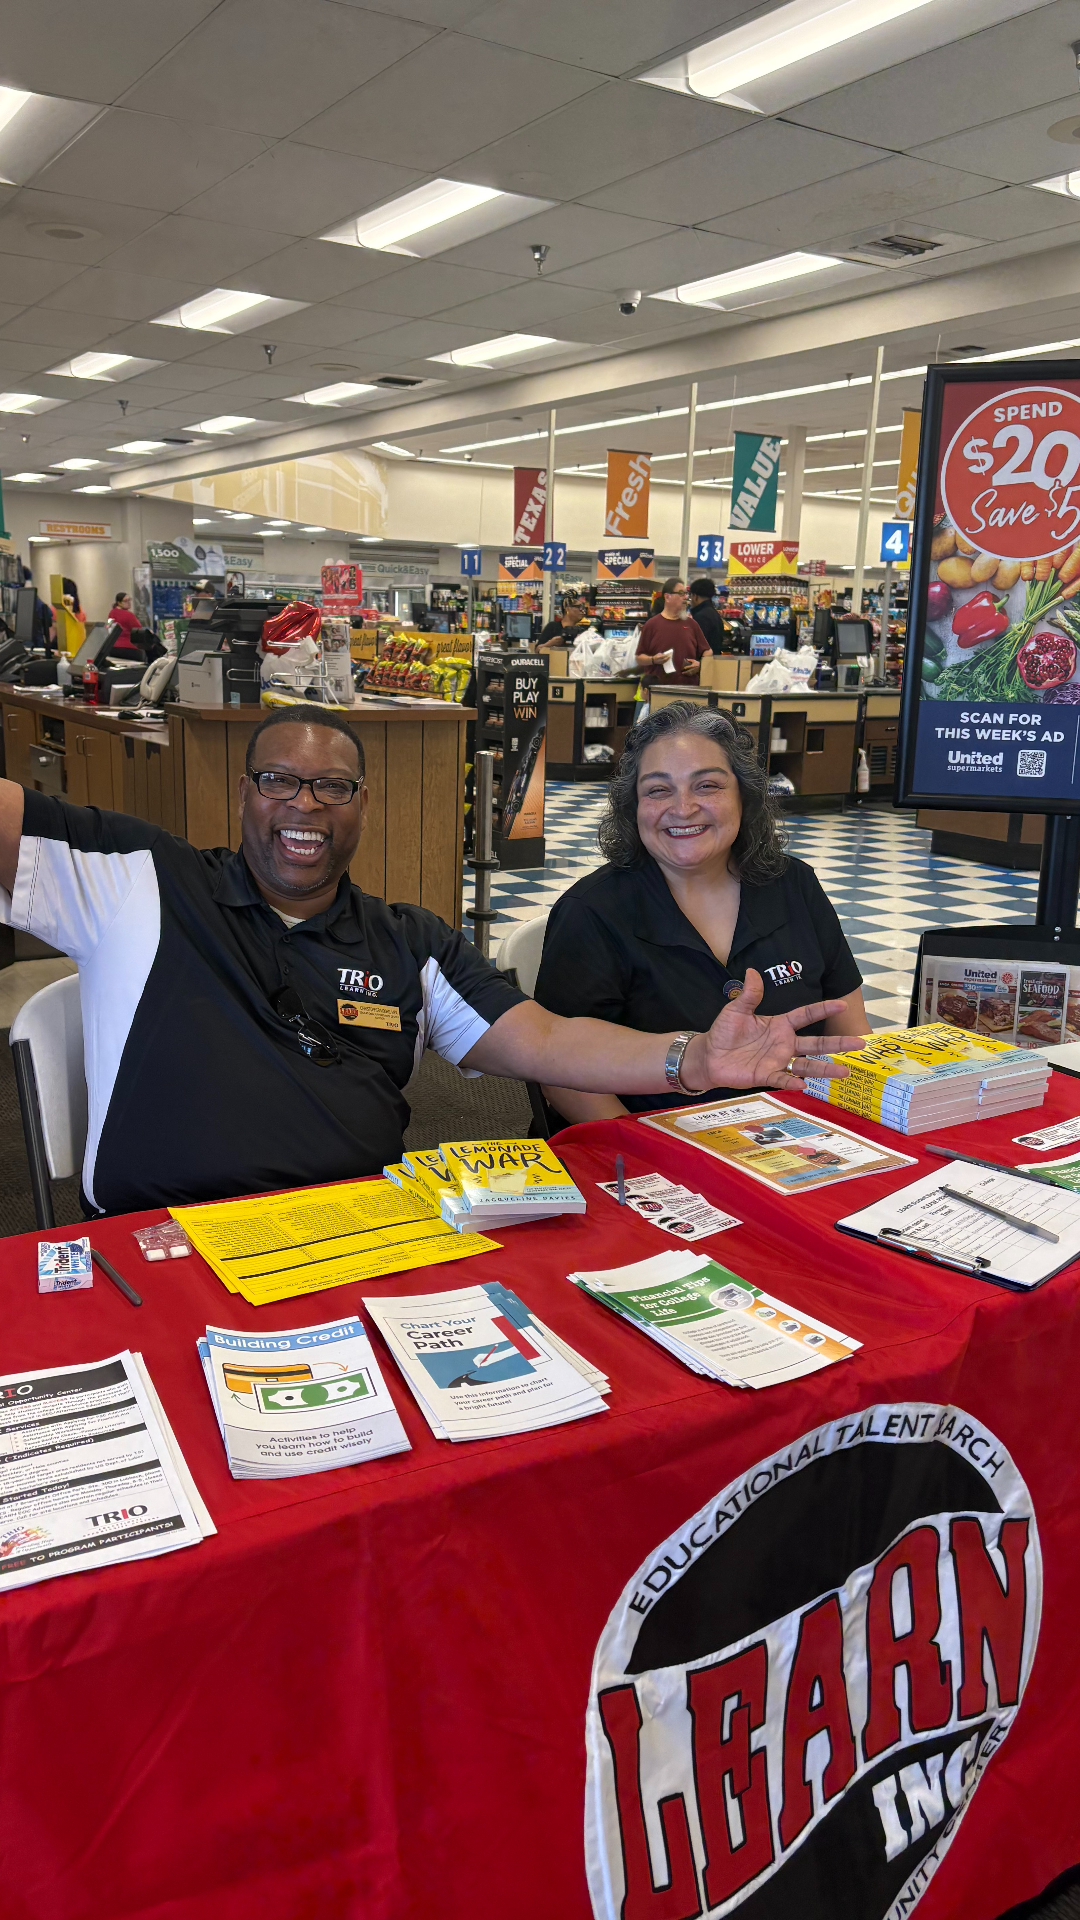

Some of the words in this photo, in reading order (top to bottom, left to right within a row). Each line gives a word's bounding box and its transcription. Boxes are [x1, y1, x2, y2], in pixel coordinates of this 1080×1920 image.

[994, 401, 1063, 422] SPEND
[962, 424, 1080, 491] $20
[729, 436, 782, 529] VALUE
[605, 454, 652, 536] Fresh
[514, 470, 547, 544] TEXAS
[965, 488, 1040, 534] Save
[46, 523, 105, 535] RESTROOMS
[738, 544, 774, 556] LOWER
[885, 529, 904, 555] 4
[151, 549, 179, 558] 1,500
[545, 548, 553, 565] 2
[556, 548, 564, 566] 2
[699, 540, 709, 562] 3
[713, 541, 723, 562] 3
[223, 555, 253, 569] &Easy
[463, 554, 468, 570] 1
[473, 554, 478, 571] 1
[504, 560, 528, 568] SPECIAL
[604, 555, 632, 566] SPECIAL
[377, 563, 430, 576] Quick&Easy
[511, 658, 545, 667] DURACELL
[515, 678, 539, 690] BUY
[513, 691, 540, 703] PLAY
[513, 706, 537, 719] WIN
[960, 711, 1004, 724] SCAN
[1008, 713, 1042, 726] FOR
[935, 727, 971, 740] THIS
[975, 729, 1037, 742] WEEK'S
[1041, 731, 1065, 743] AD
[948, 750, 1004, 766] United
[947, 764, 1003, 773] supermarkets
[964, 968, 998, 979] United
[340, 986, 364, 994] LEARN
[1022, 983, 1060, 995] SEAFOOD
[912, 1030, 998, 1052] WAR
[845, 1042, 932, 1064] WAR
[449, 1143, 546, 1159] LEMONADE
[458, 1152, 562, 1174] WAR
[54, 1246, 70, 1274] Trident
[70, 1251, 80, 1268] WHITE
[628, 1285, 685, 1304] Financial
[682, 1275, 711, 1292] Tips
[639, 1299, 659, 1310] for
[660, 1290, 702, 1308] College
[651, 1307, 677, 1318] Life
[400, 1321, 442, 1330] Chart
[442, 1317, 476, 1327] Your
[214, 1334, 291, 1350] Building
[296, 1325, 355, 1345] Credit
[406, 1326, 473, 1340] Career
[413, 1338, 464, 1350] Path
[8, 1393, 54, 1406] Opportunity
[57, 1387, 83, 1397] Center
[464, 1391, 479, 1399] this
[479, 1385, 521, 1397] information
[529, 1377, 548, 1386] chart
[472, 1396, 494, 1404] career
[495, 1393, 512, 1402] path
[512, 1389, 527, 1397] and
[527, 1385, 543, 1394] plan
[543, 1381, 554, 1389] for
[464, 1403, 487, 1411] bright
[487, 1399, 513, 1408] future!
[5, 1422, 40, 1433] Services
[269, 1435, 317, 1443] Activities
[332, 1427, 357, 1436] help
[55, 1438, 94, 1450] Required)
[306, 1445, 338, 1455] credit
[340, 1437, 372, 1450] wisely
[308, 1440, 331, 1448] how
[346, 1429, 374, 1441] build
[2, 1491, 38, 1503] Started
[41, 1482, 70, 1494] Today!
[85, 1504, 148, 1527] TRIO
[628, 1441, 826, 1616] EDUCATIONAL
[836, 1414, 936, 1446] TALENT
[934, 1412, 1006, 1479] ARCH
[1, 1559, 26, 1571] FREE
[30, 1554, 45, 1563] TO
[48, 1541, 97, 1558] PROGRAM
[99, 1521, 174, 1546] PARTICIPANTS!
[598, 1515, 1031, 1920] LEARN
